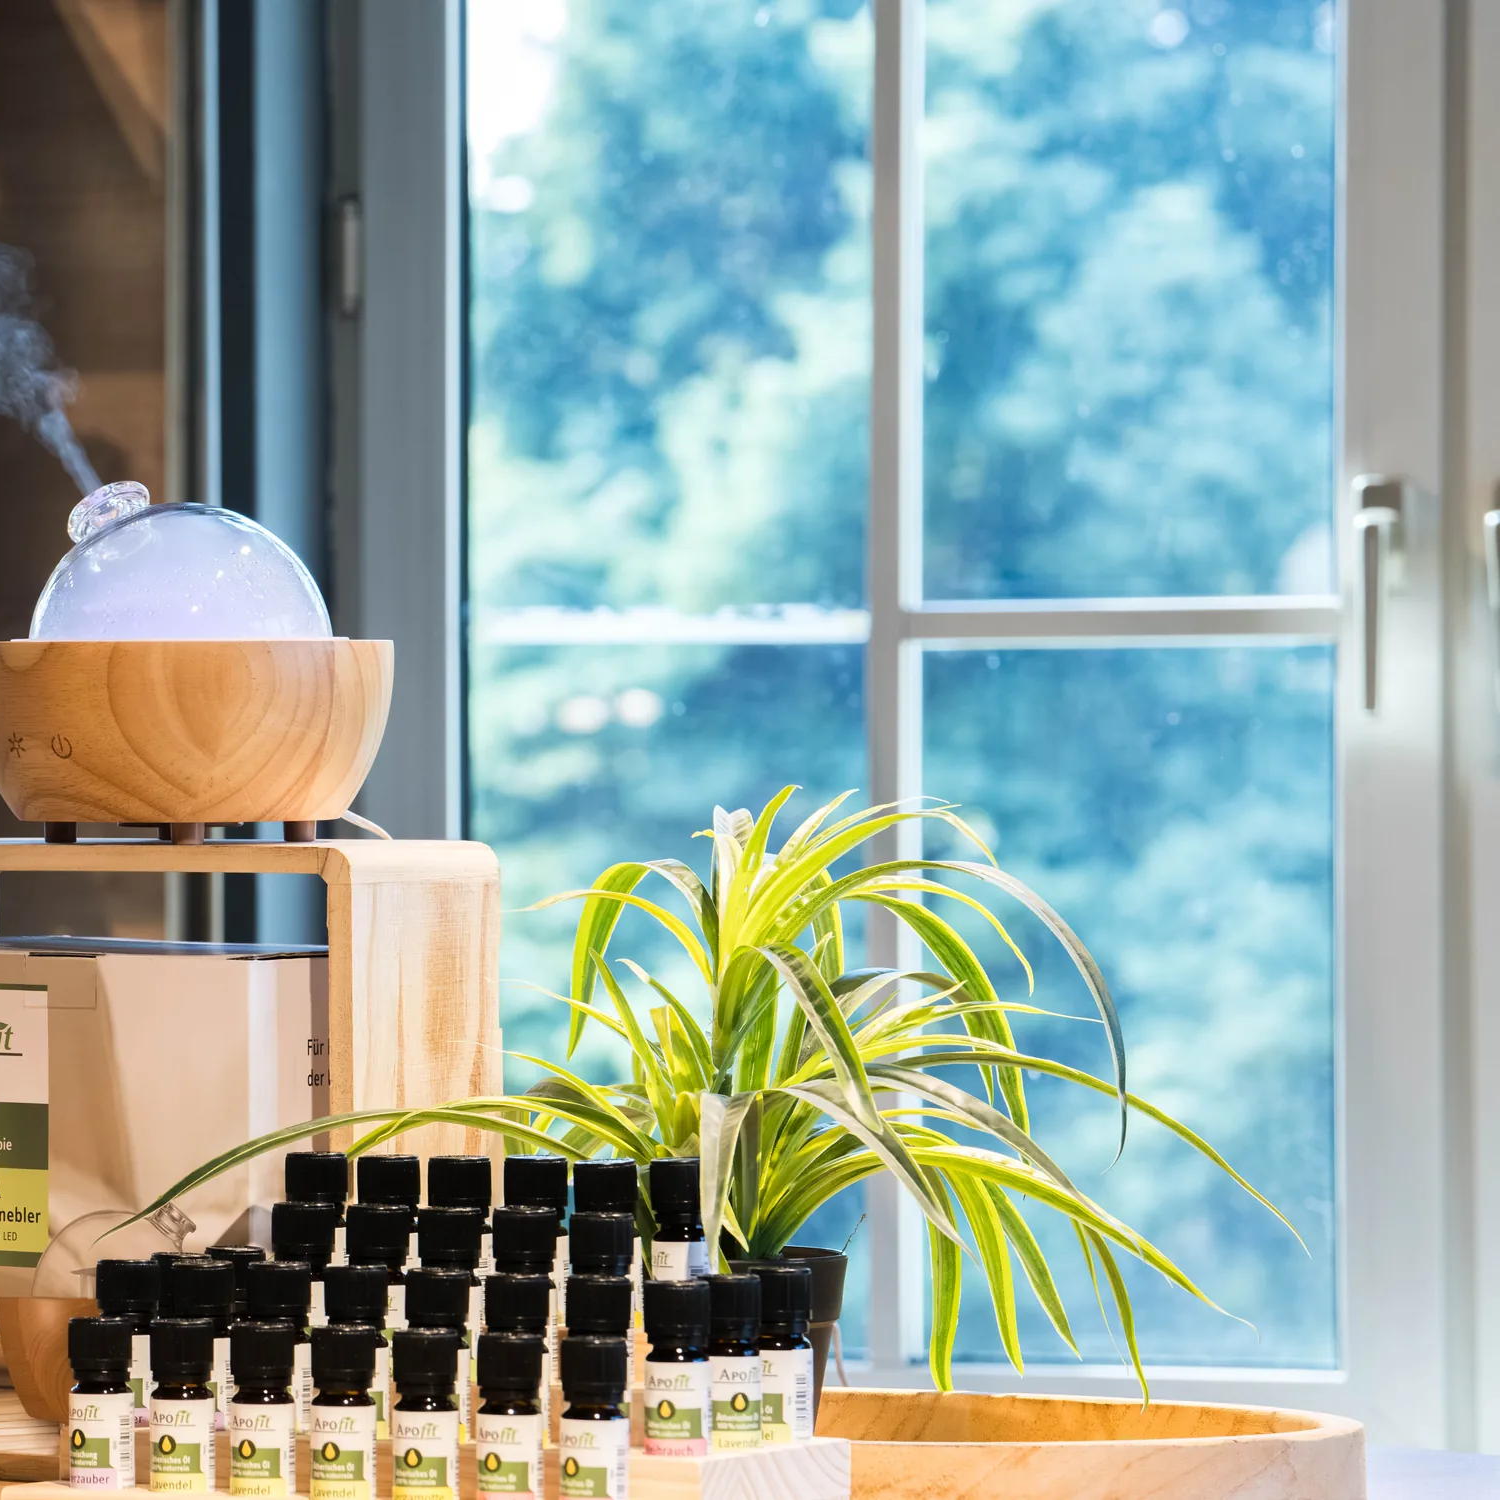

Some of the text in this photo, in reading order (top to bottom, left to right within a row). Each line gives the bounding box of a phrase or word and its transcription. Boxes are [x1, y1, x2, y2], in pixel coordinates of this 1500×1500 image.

[307, 1038, 325, 1056] Für
[307, 1068, 325, 1087] der
[3, 1231, 18, 1241] LED
